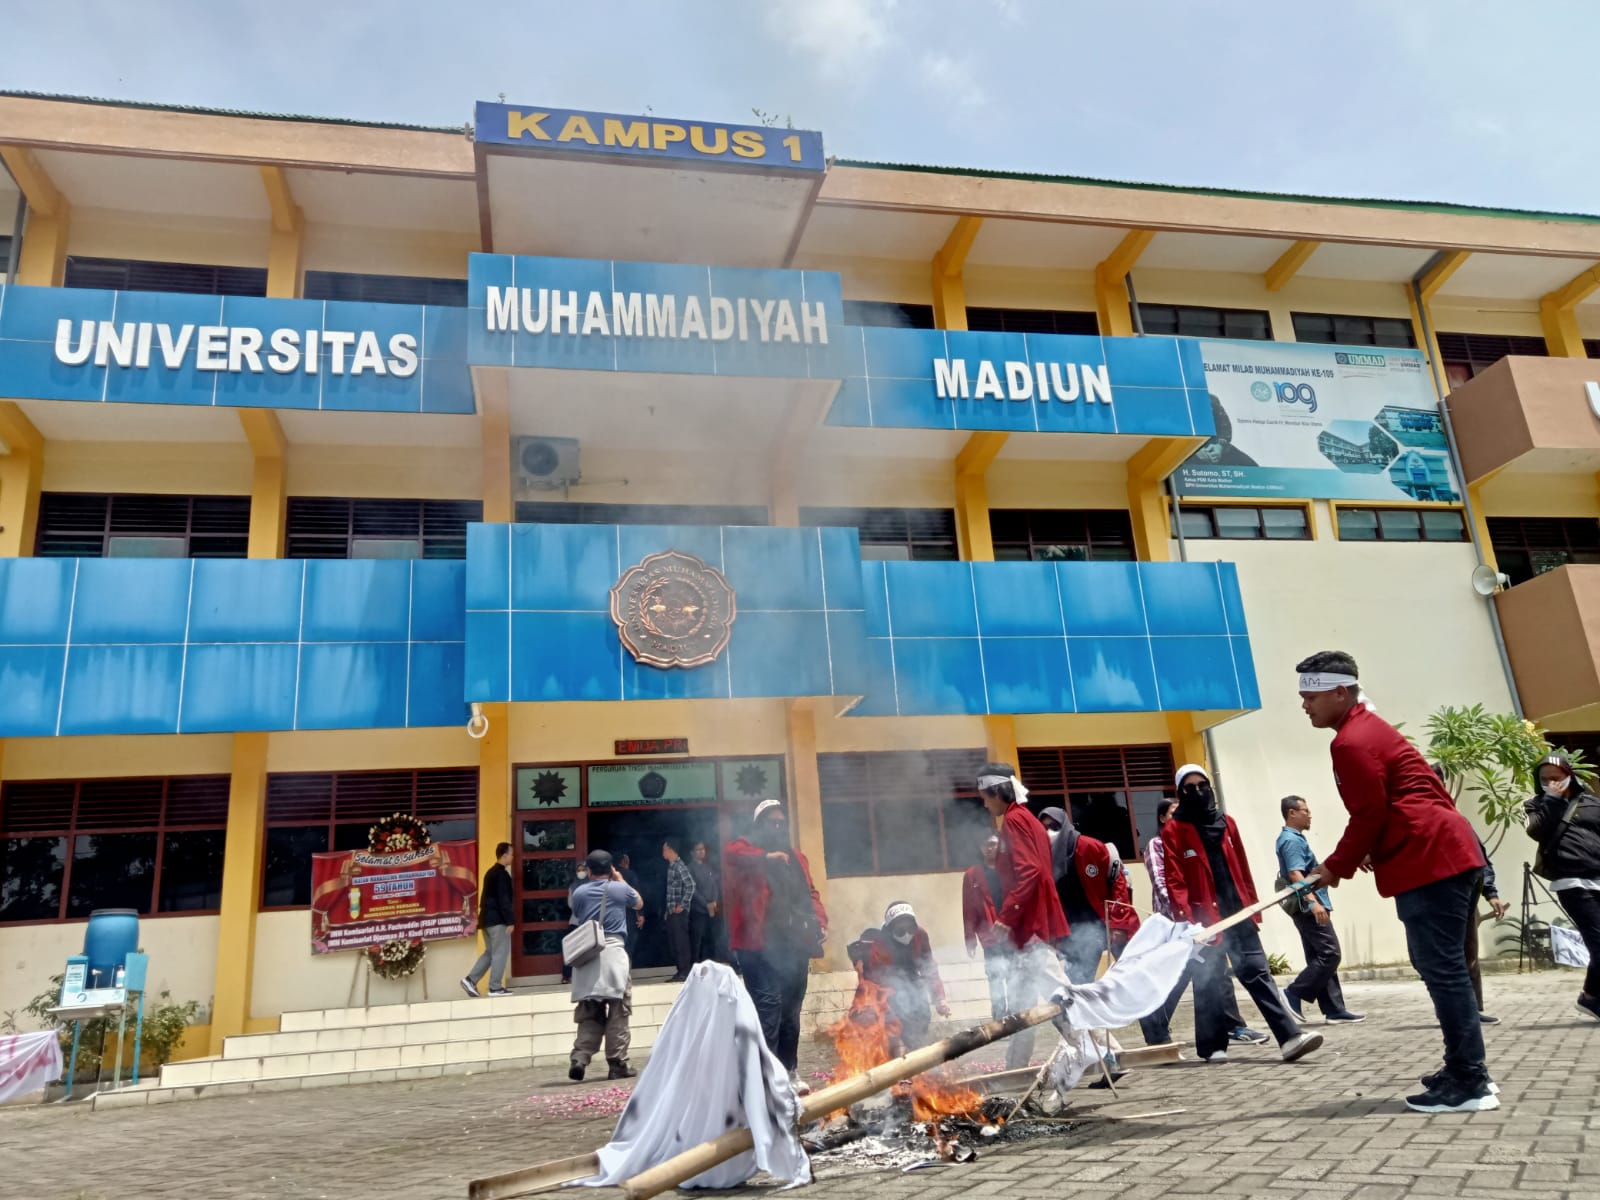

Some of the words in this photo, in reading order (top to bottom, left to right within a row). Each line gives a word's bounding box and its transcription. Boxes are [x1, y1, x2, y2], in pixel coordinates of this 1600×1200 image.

[507, 111, 766, 158] KAMPUS
[782, 136, 801, 161] 1
[486, 286, 828, 345] MUHAMMADIYAH
[55, 320, 418, 377] UNIVERSITAS
[1347, 354, 1384, 366] UMMAD
[934, 358, 1112, 404] MADIUN
[1232, 365, 1253, 374] MILAD
[1255, 366, 1310, 377] MUHAMMADIYAH
[354, 853, 394, 865] Selamat
[403, 846, 435, 863] Sukses
[374, 884, 386, 893] 59
[387, 881, 414, 891] TAHUN
